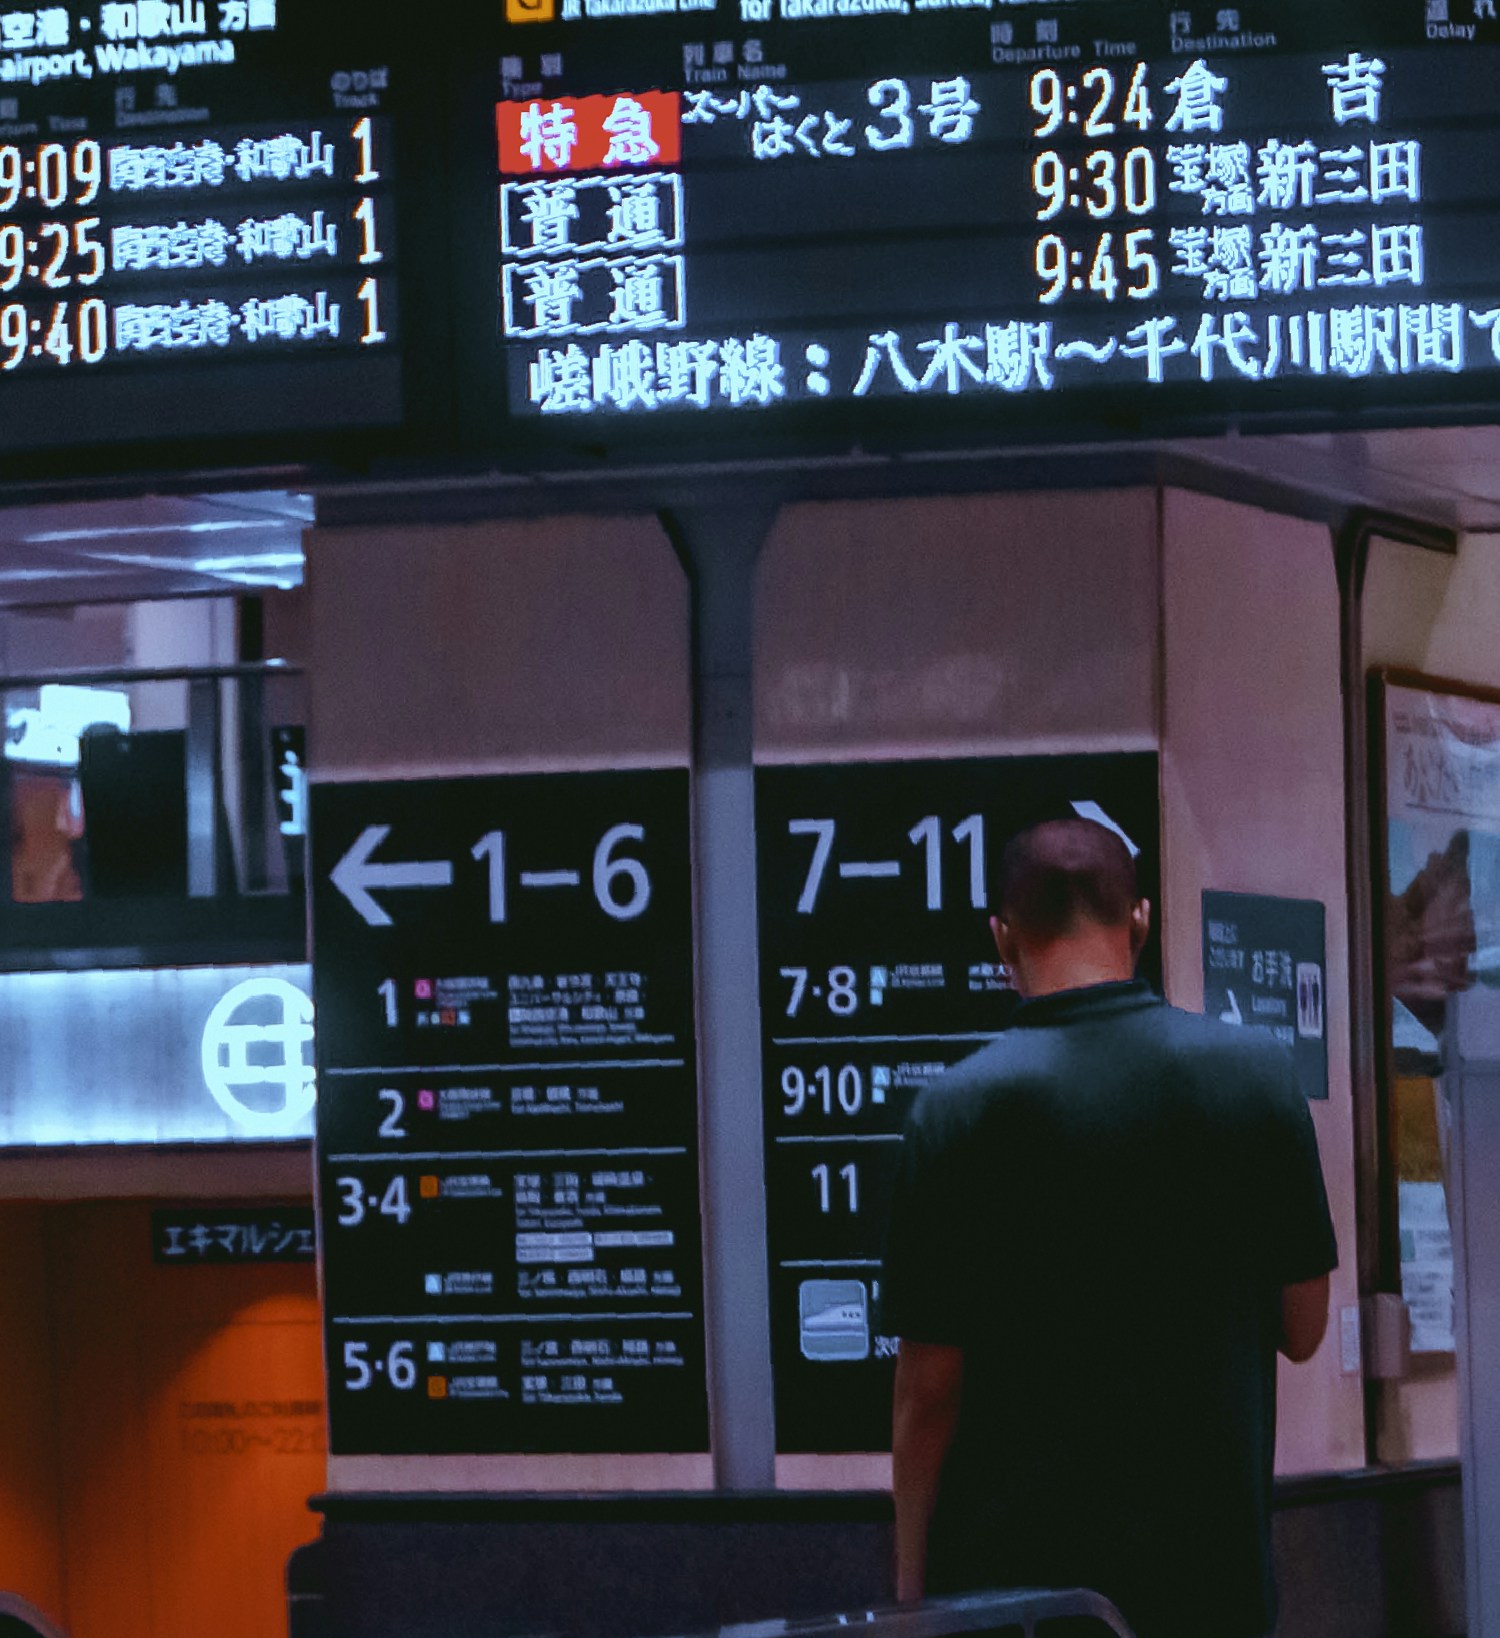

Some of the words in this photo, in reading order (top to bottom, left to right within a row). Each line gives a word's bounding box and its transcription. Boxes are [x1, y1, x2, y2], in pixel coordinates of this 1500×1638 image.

[96, 38, 236, 76] Wakayama
[992, 42, 1082, 64] Departure
[1093, 39, 1137, 58] Time
[1170, 32, 1278, 53] Destination
[519, 97, 660, 169] 特急
[1029, 61, 1153, 138] 9:24
[0, 140, 101, 212] 9:09
[352, 116, 380, 184] 1
[528, 184, 664, 252] 普通
[1031, 144, 1156, 222] 9:30
[0, 217, 106, 292] 9:25
[353, 197, 383, 264] 1
[529, 264, 664, 331] 普通
[1034, 228, 1160, 305] 9:45
[0, 298, 108, 372] 9:40
[356, 276, 387, 344] 1
[378, 978, 398, 1028] 1
[378, 1088, 408, 1139] 2
[811, 1162, 859, 1214] 11
